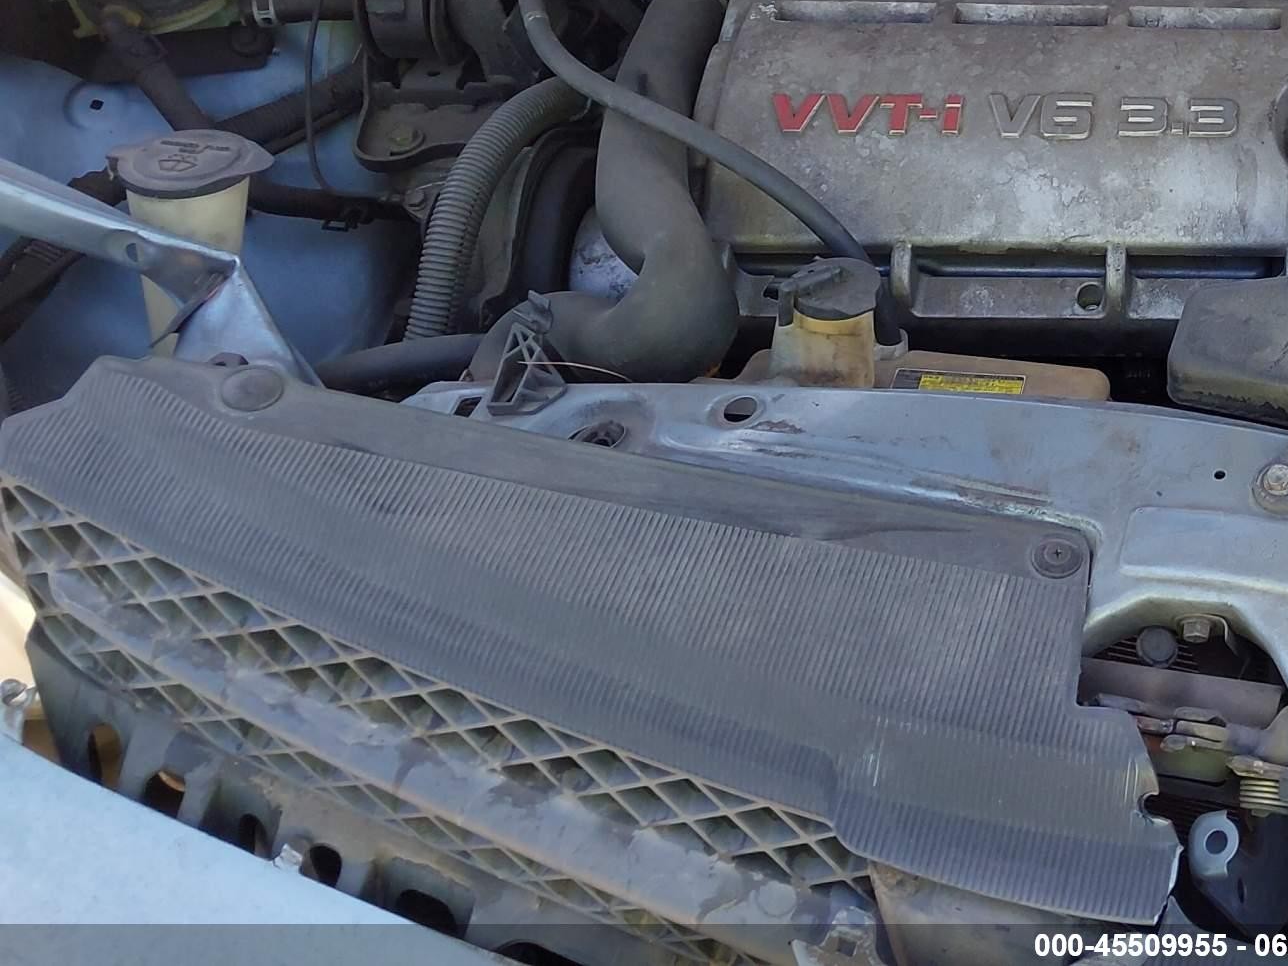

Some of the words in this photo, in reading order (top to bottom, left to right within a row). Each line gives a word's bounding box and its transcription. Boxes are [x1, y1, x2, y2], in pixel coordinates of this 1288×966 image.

[771, 92, 964, 136] VVT-i
[989, 91, 1095, 140] V6
[1118, 95, 1241, 138] 3.3
